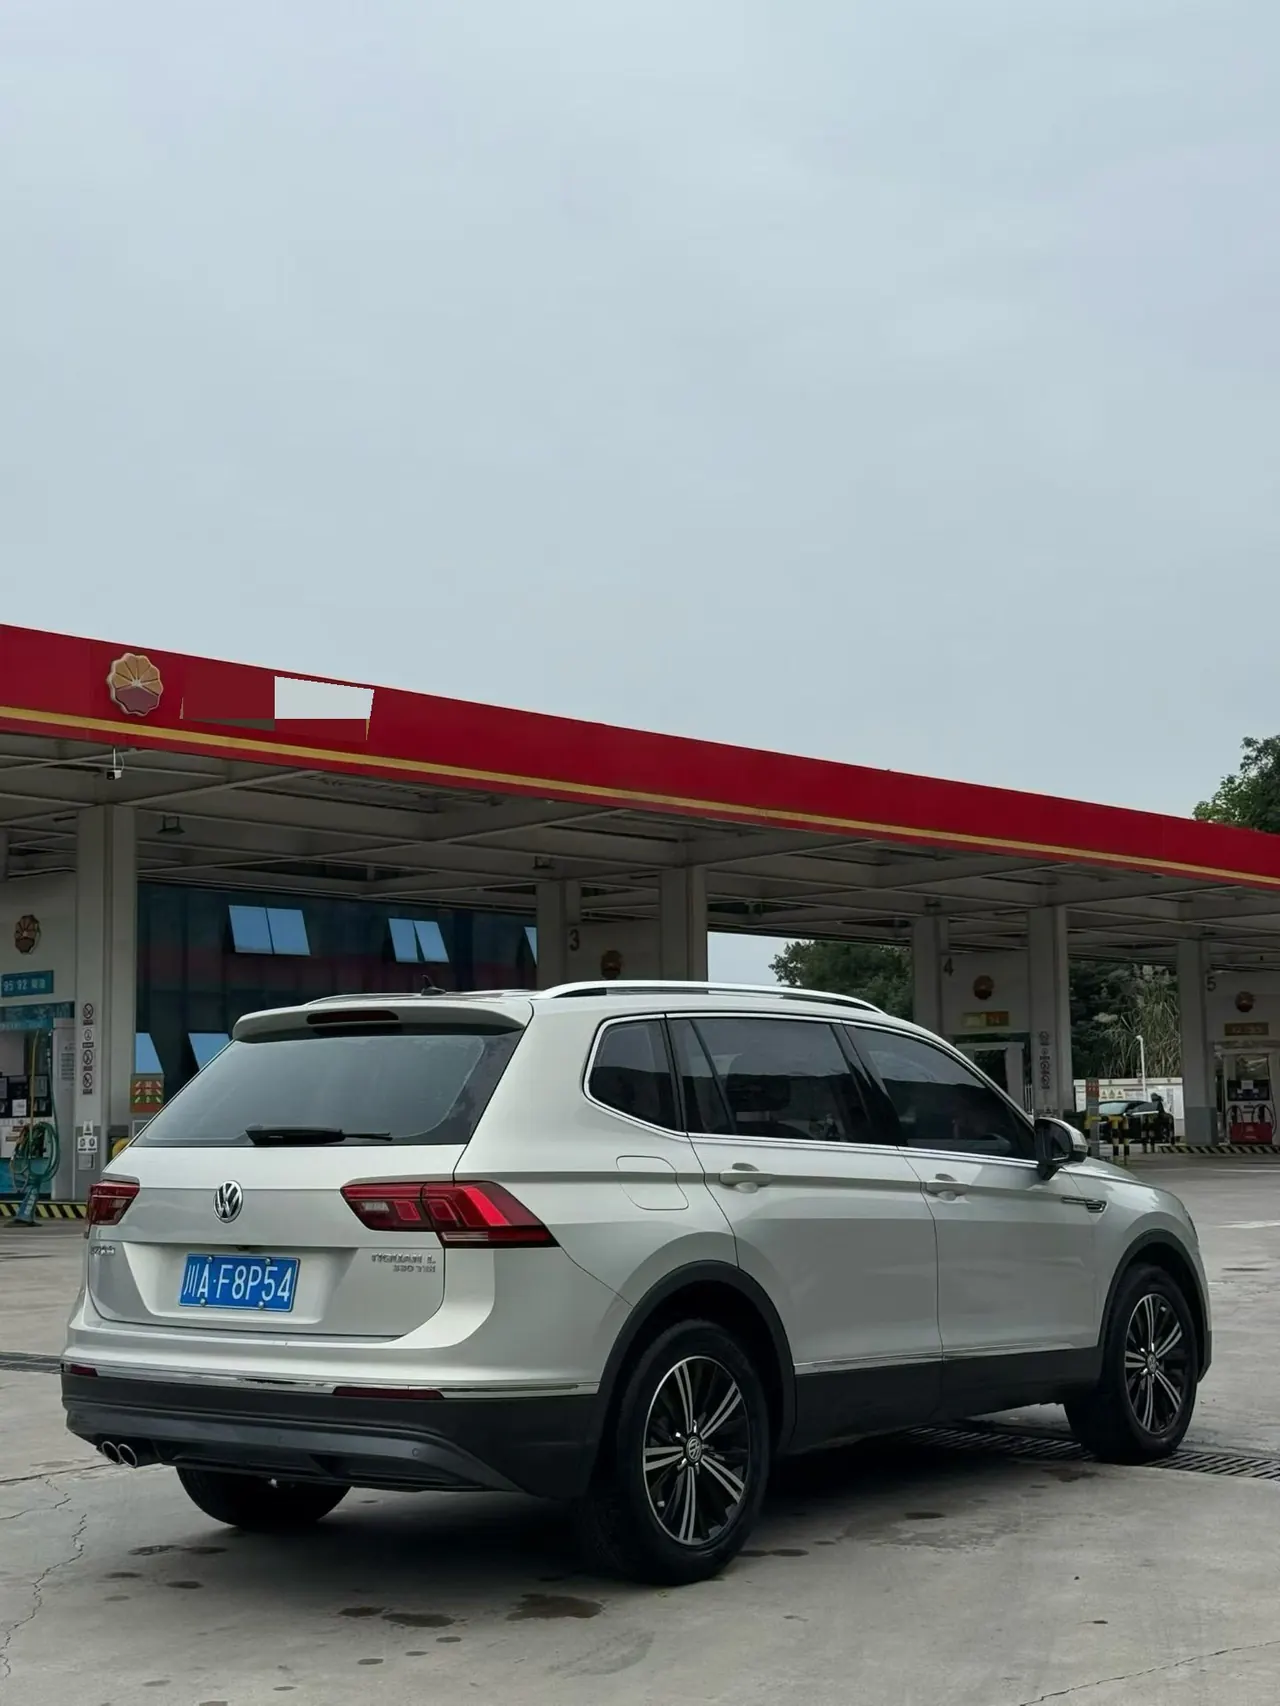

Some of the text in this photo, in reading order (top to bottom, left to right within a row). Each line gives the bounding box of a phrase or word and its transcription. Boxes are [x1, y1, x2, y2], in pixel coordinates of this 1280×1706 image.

[569, 929, 580, 951] 3
[943, 957, 954, 976] 4
[1206, 976, 1217, 992] 5
